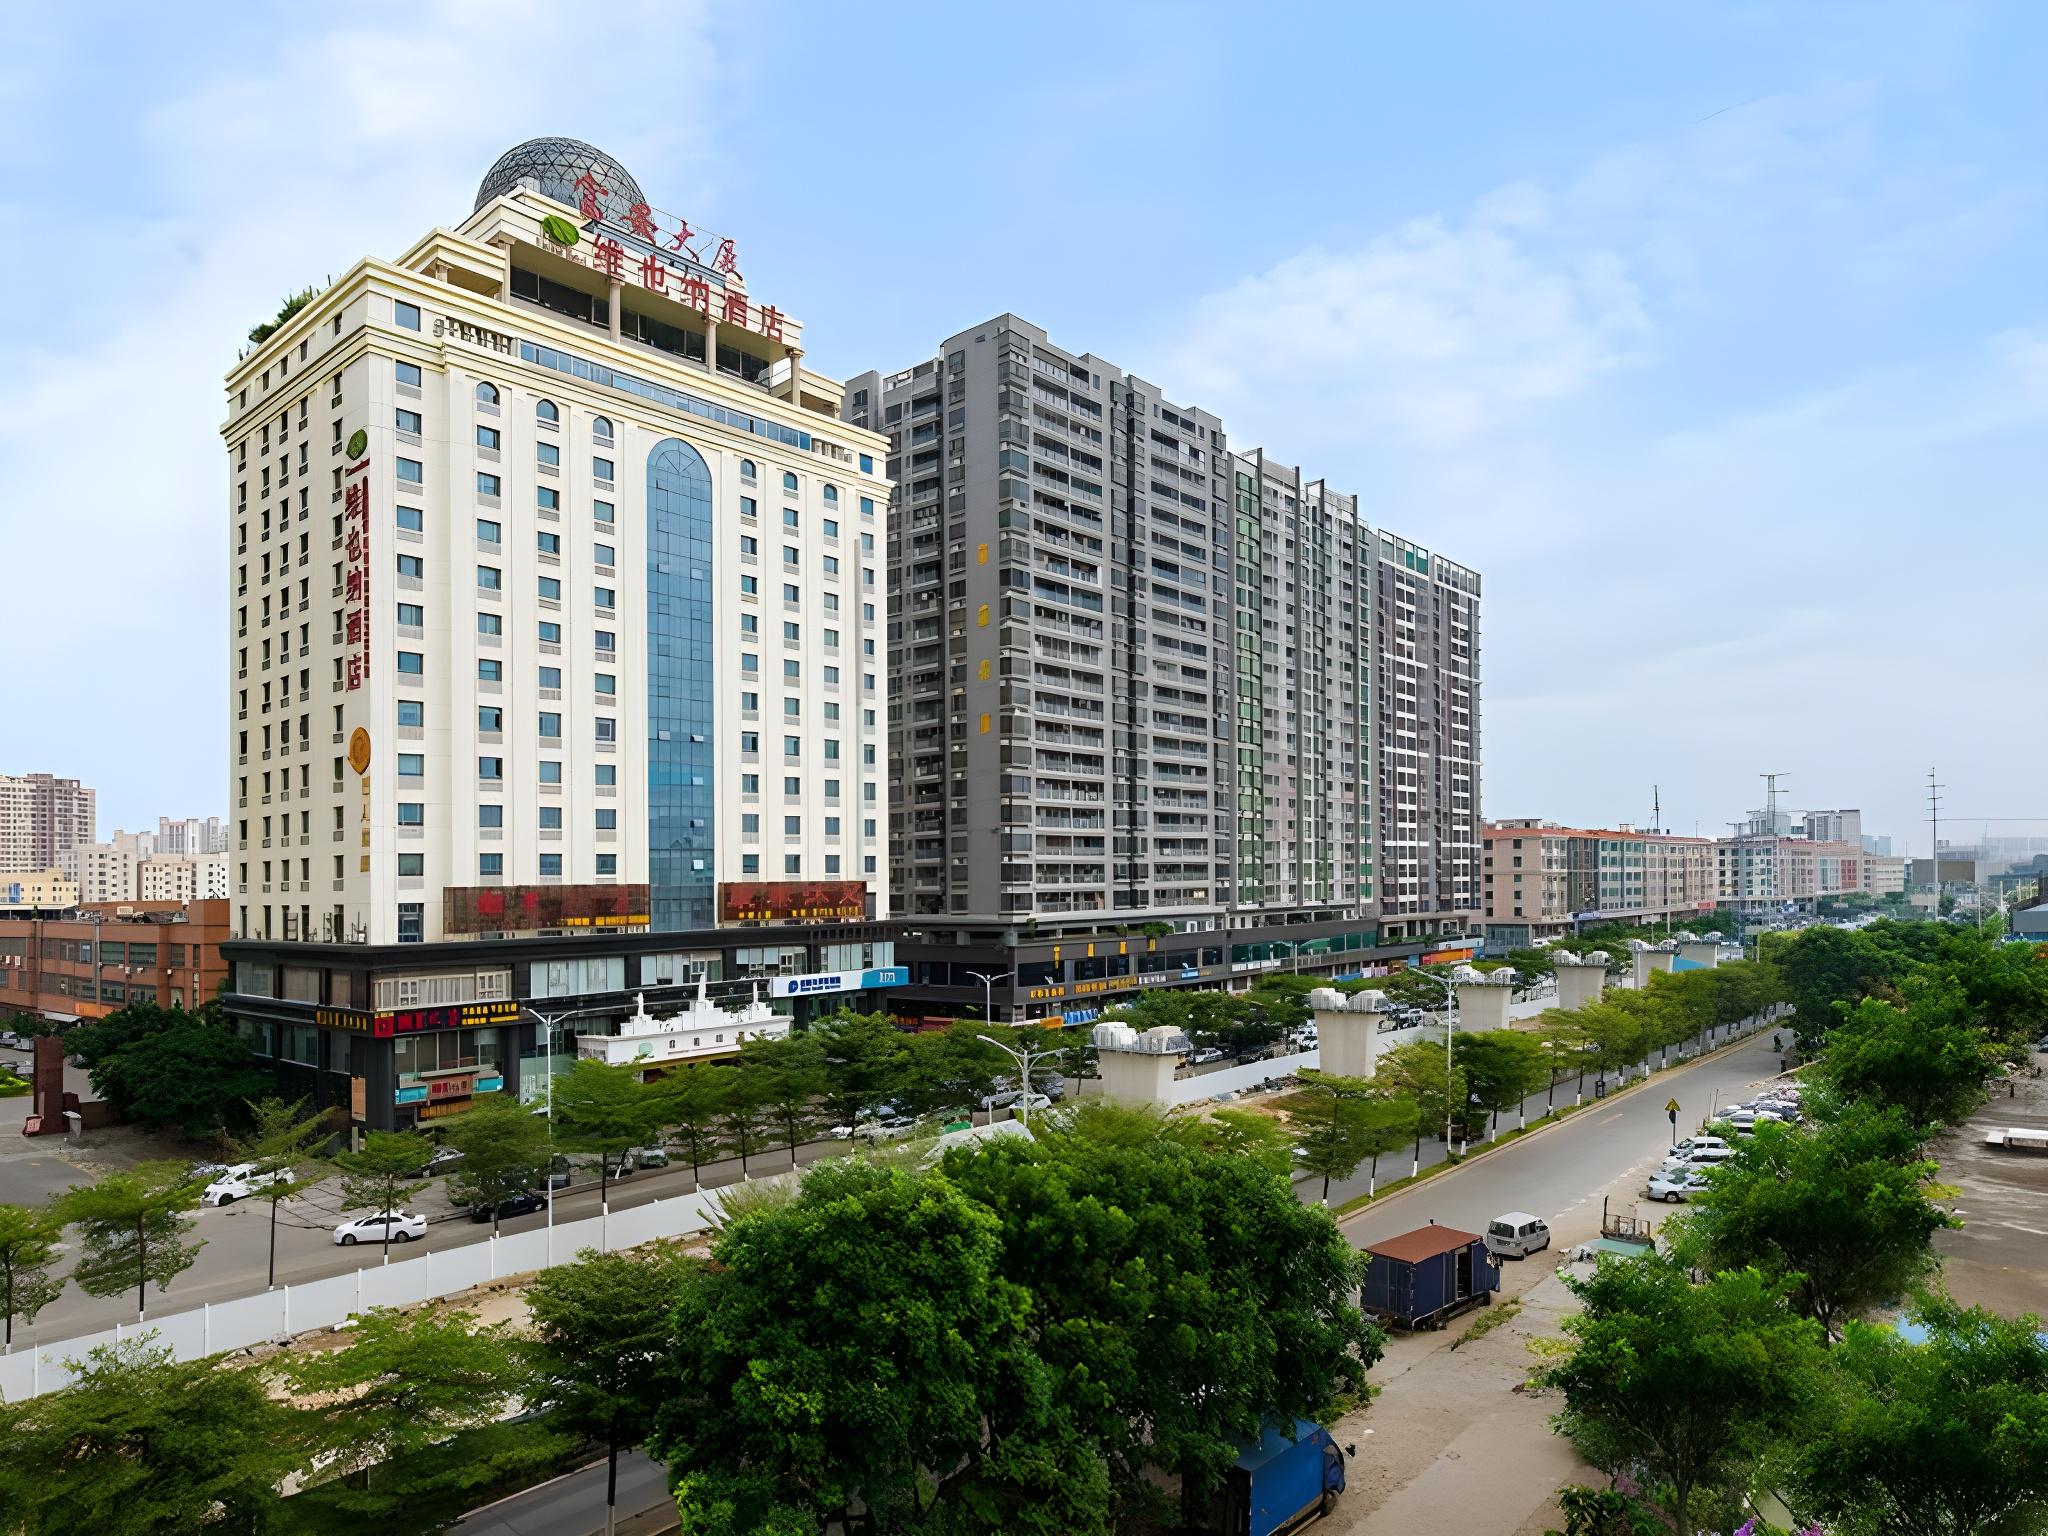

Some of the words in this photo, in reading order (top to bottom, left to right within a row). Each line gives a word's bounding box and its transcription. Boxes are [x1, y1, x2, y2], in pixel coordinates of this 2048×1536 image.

[592, 233, 785, 344] 维也纳酒店
